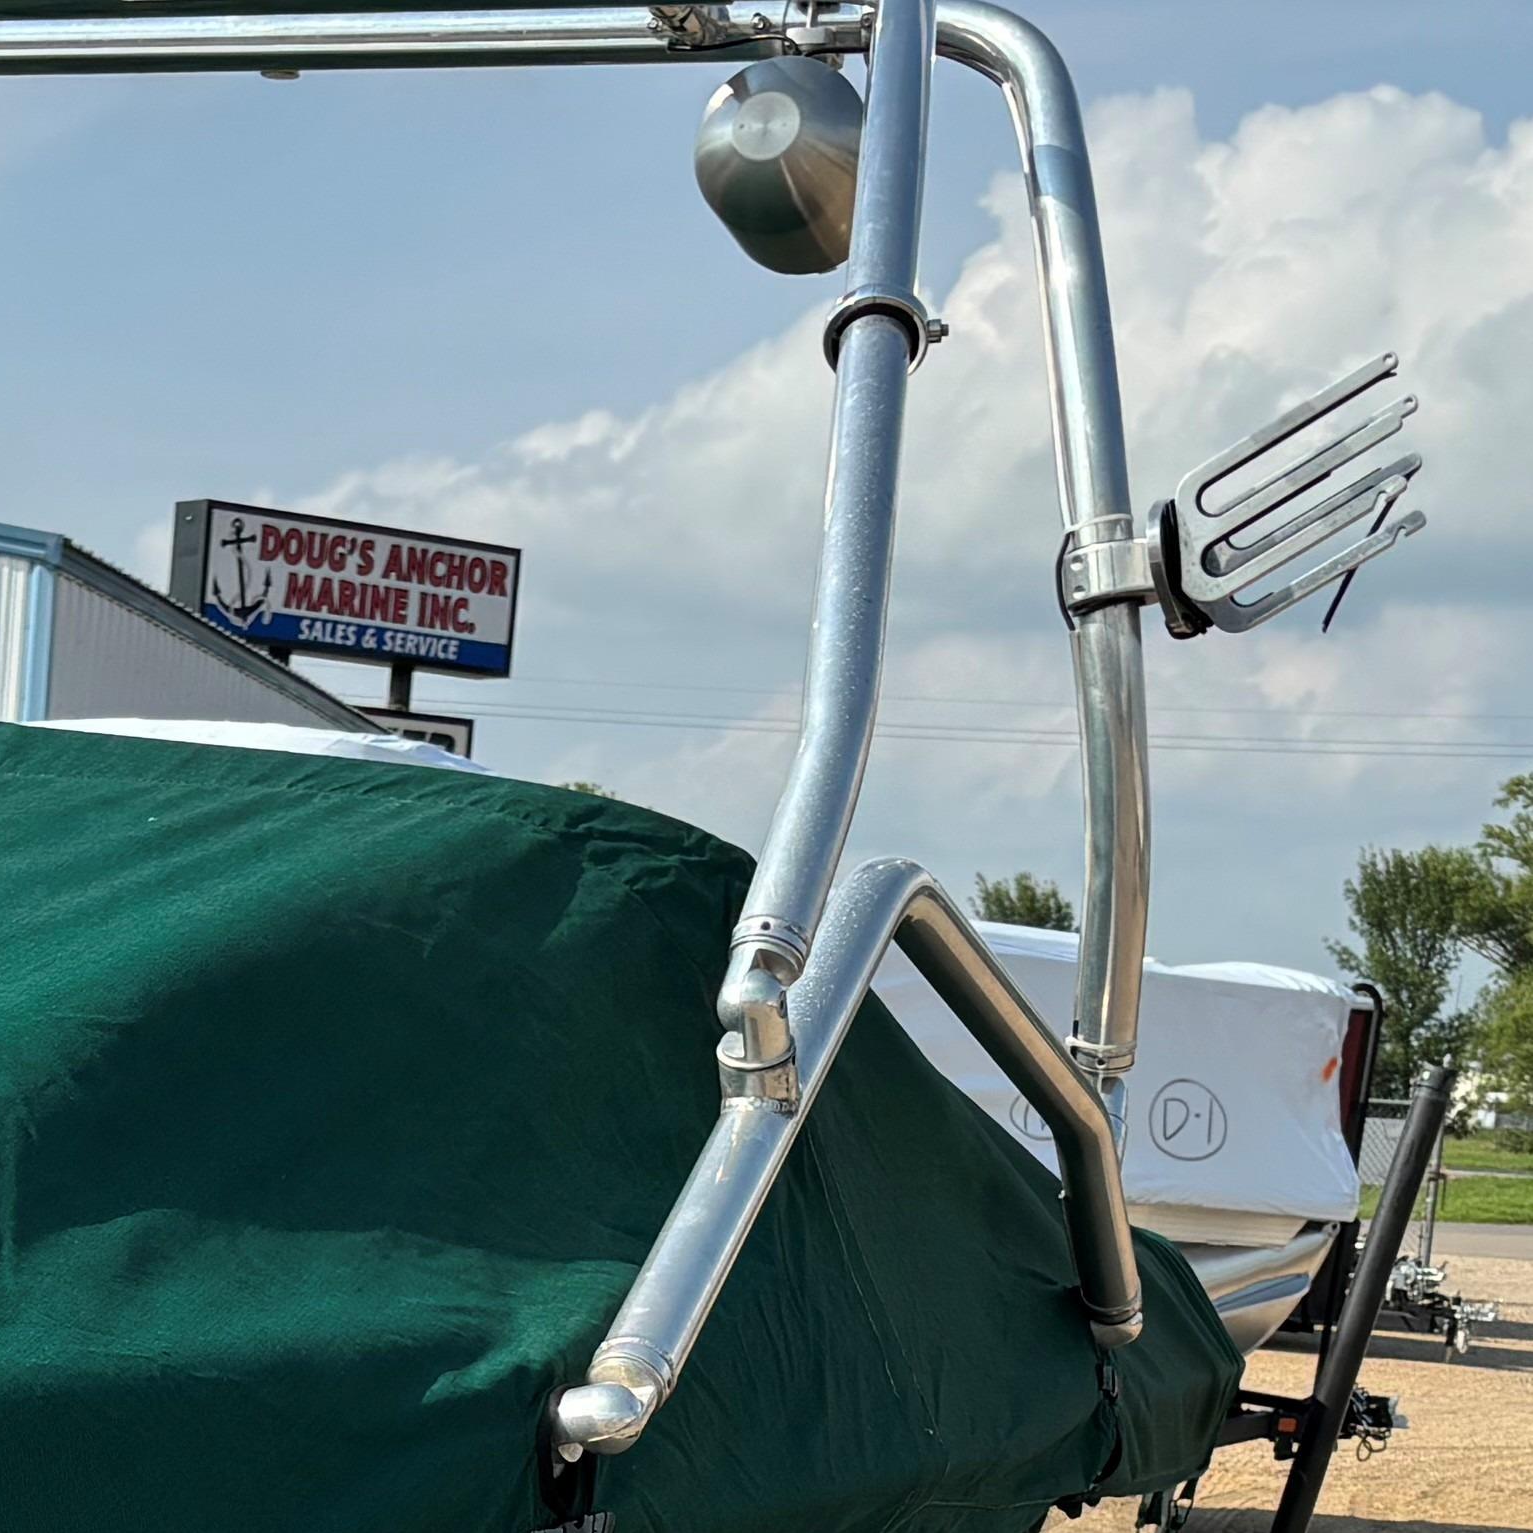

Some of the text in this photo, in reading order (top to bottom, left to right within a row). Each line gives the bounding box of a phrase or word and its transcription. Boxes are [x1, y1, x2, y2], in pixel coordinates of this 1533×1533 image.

[258, 523, 508, 597] DOUG'S ANCHOR
[284, 572, 476, 635] MARINE INC.
[297, 618, 460, 661] SALES & SERVICE
